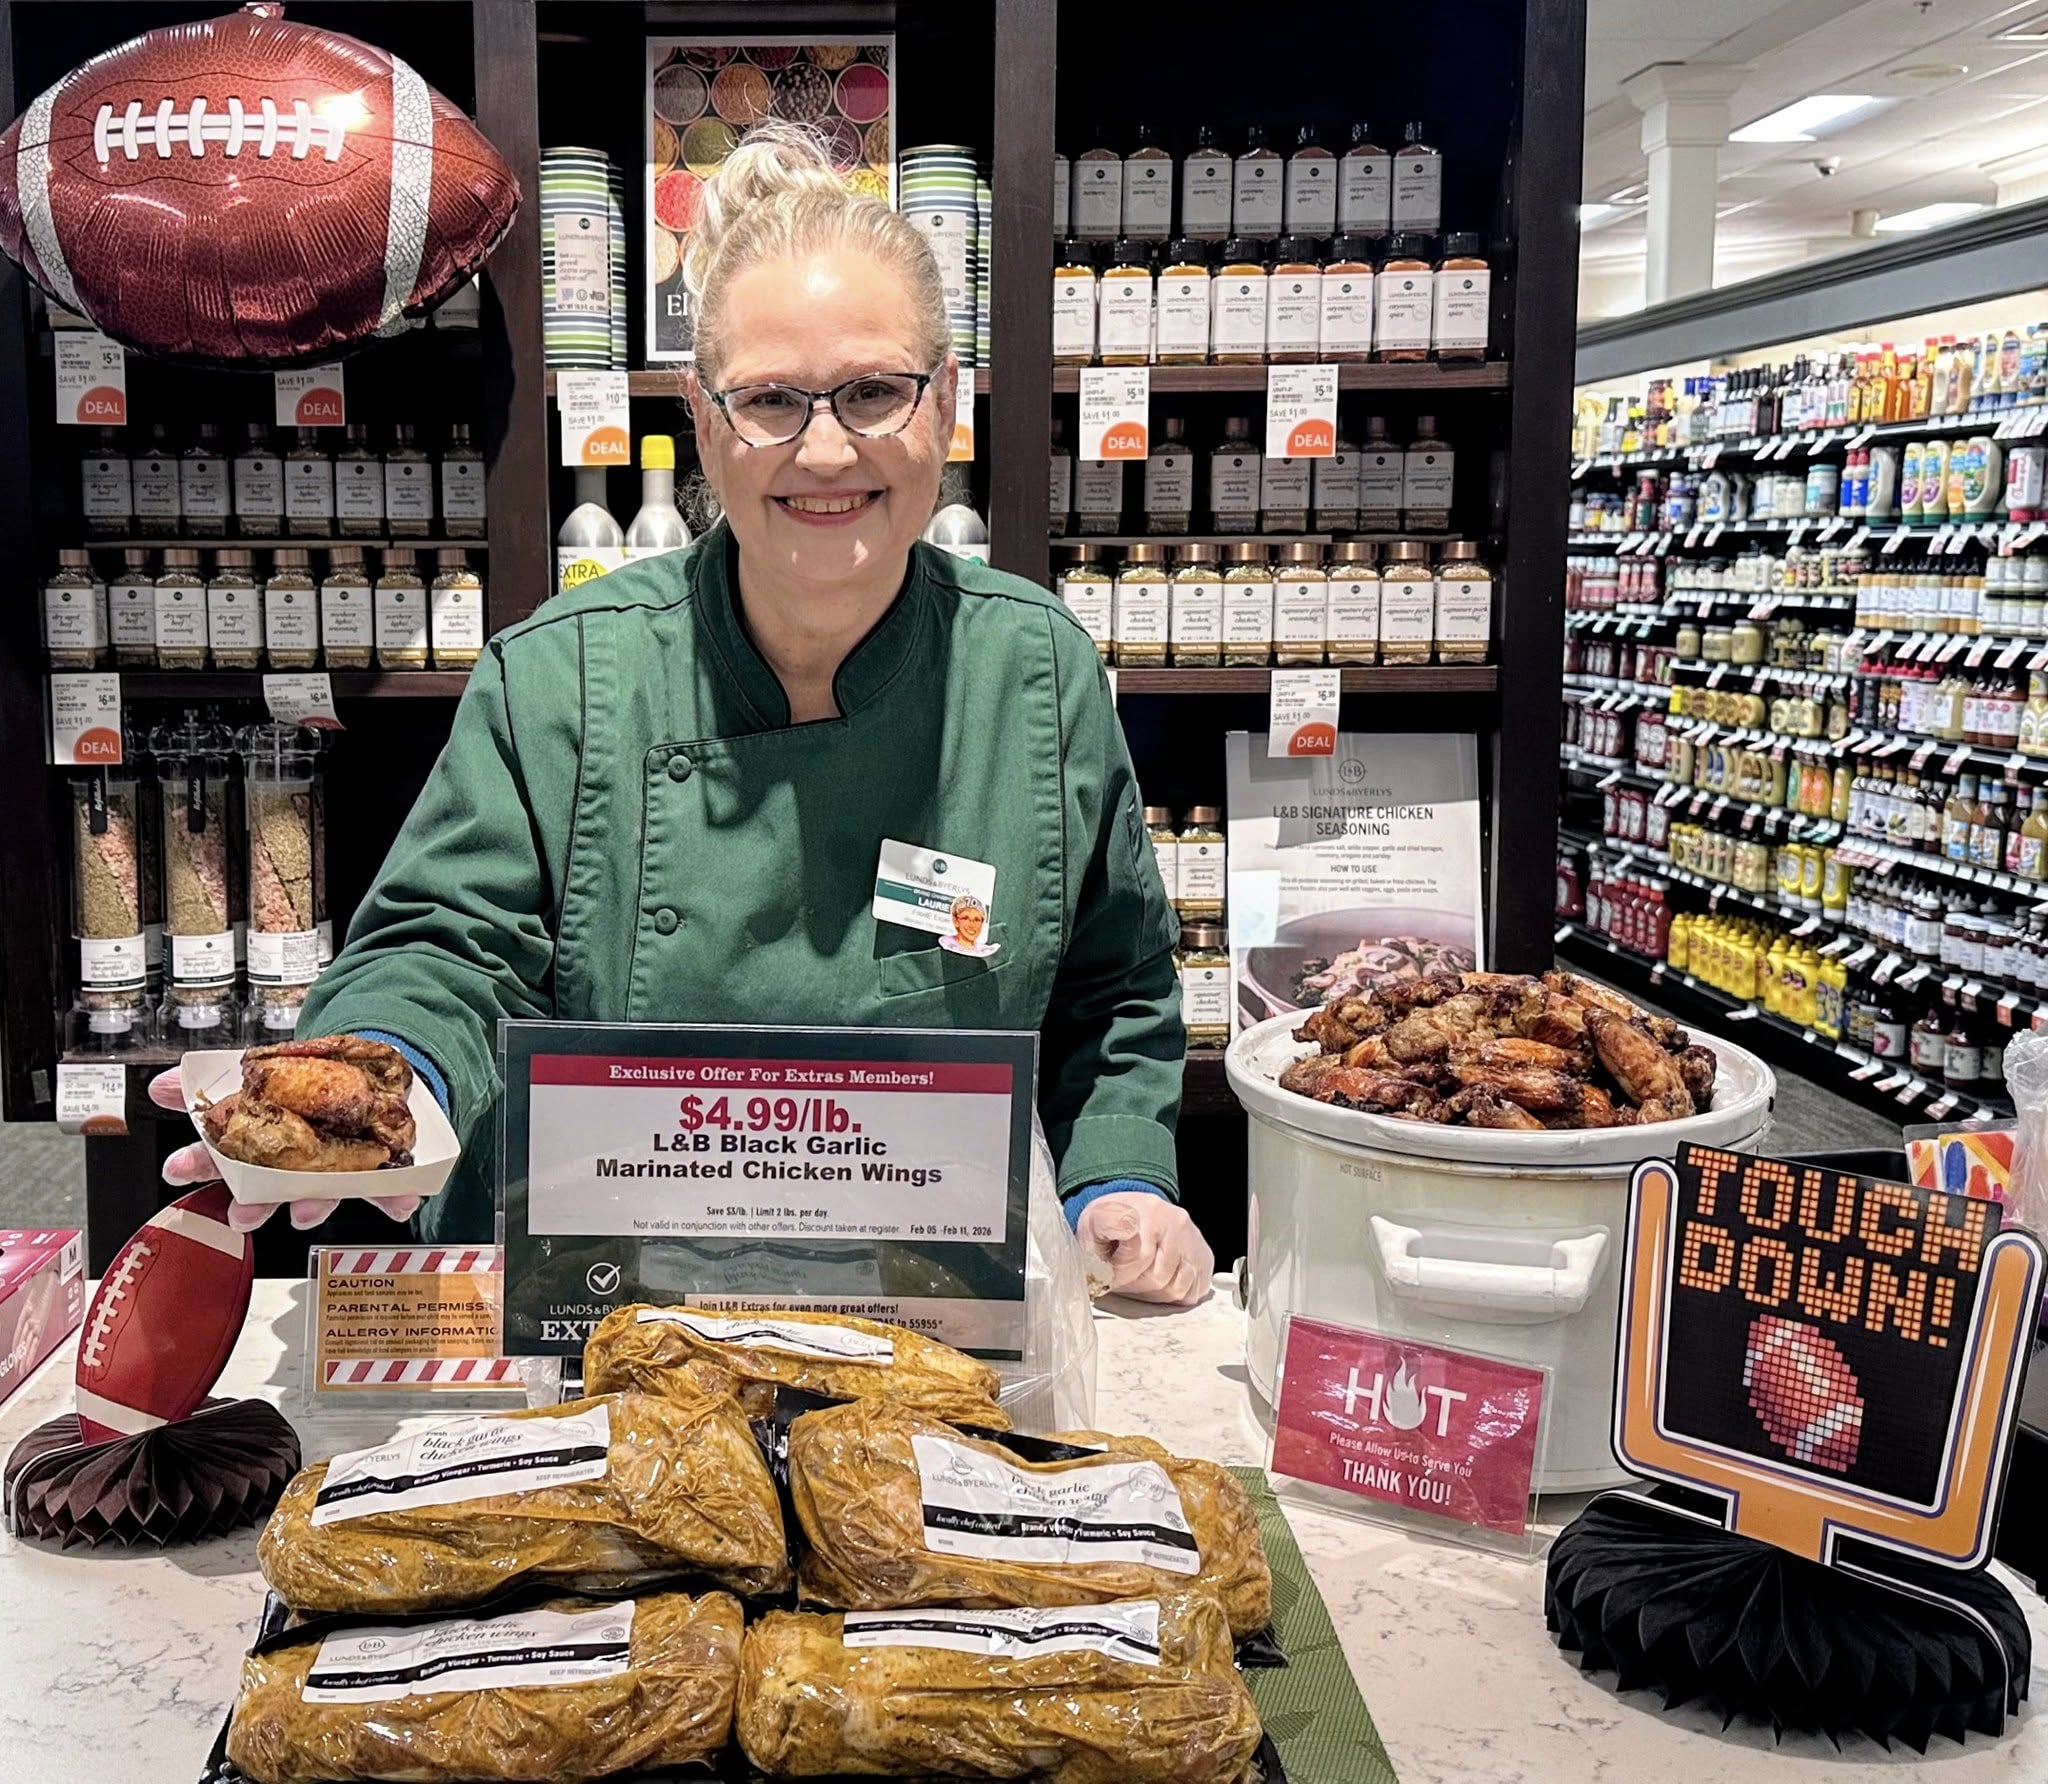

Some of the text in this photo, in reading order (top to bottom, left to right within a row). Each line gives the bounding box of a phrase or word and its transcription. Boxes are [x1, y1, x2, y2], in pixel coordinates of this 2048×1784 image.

[85, 401, 121, 414] DEAL
[303, 403, 339, 416] DEAL
[1083, 411, 1100, 419] SAVE
[1269, 409, 1286, 417] SAVE
[590, 441, 625, 455] DEAL
[1108, 437, 1143, 449] DEAL
[1294, 434, 1329, 447] DEAL
[559, 564, 600, 579] EXTRA
[82, 742, 116, 754] DEAL
[1296, 736, 1331, 748] DEAL
[1273, 806, 1433, 820] L&B SIGNATURE CHICKEN
[1316, 823, 1390, 835] SEASONING
[1331, 865, 1377, 873] HOW TO USE
[918, 897, 950, 912] LAURIE
[609, 1065, 934, 1085] Exclusive Offer For Extras Members!
[679, 1094, 862, 1134] $4.99/lb.
[654, 1133, 887, 1155] L&B Black Garlic
[596, 1158, 942, 1187] Marinated Chicken Wings
[706, 1206, 724, 1216] Save
[756, 1207, 774, 1217] Limit
[776, 1207, 781, 1217] 2
[784, 1207, 797, 1217] lbs.
[800, 1209, 812, 1219] per
[1687, 1146, 1986, 1272] TOUCH
[633, 1220, 648, 1230] Not
[650, 1220, 670, 1230] valid
[672, 1220, 679, 1230] in
[681, 1220, 728, 1232] conjunction
[730, 1221, 746, 1231] with
[748, 1221, 769, 1231] other
[799, 1222, 833, 1232] Discount
[835, 1223, 857, 1233] taken
[859, 1224, 867, 1233] at
[910, 1225, 925, 1235] Feb
[927, 1225, 937, 1235] 05
[973, 1226, 992, 1237] 2026
[69, 1243, 77, 1265] M
[328, 1279, 394, 1288] CAUTION
[1679, 1220, 1956, 1348] DOWN!
[327, 1302, 497, 1313] PARENTAL PERMISS
[720, 1301, 738, 1312] L&B
[741, 1302, 770, 1312] Extras
[773, 1302, 785, 1312] for
[789, 1303, 811, 1313] even
[813, 1303, 837, 1313] more
[840, 1303, 865, 1315] great
[867, 1303, 899, 1314] offers!
[540, 1320, 598, 1341] EXT
[897, 1318, 907, 1328] to
[326, 1327, 399, 1337] ALLERGY
[420, 1432, 524, 1461] chicken wings
[422, 1433, 465, 1448] black
[1330, 1432, 1362, 1451] Please
[1365, 1441, 1392, 1458] Allow
[1408, 1451, 1419, 1465] to
[1422, 1454, 1450, 1472] Serve
[1453, 1461, 1472, 1478] You
[414, 1455, 559, 1486] Brandy Vinegar Turmeric Soy Sauce
[932, 1473, 999, 1489] LUNDS&BYERLYS
[1343, 1458, 1451, 1506] THANK YOU!
[1049, 1482, 1090, 1498] garlic
[1021, 1521, 1048, 1534] Brandy
[1117, 1528, 1131, 1539] Soy
[1133, 1528, 1156, 1538] Sauce
[425, 1632, 488, 1647] chicken
[420, 1649, 575, 1678] Brandy Vinegar Turmeric Soy Sauce
